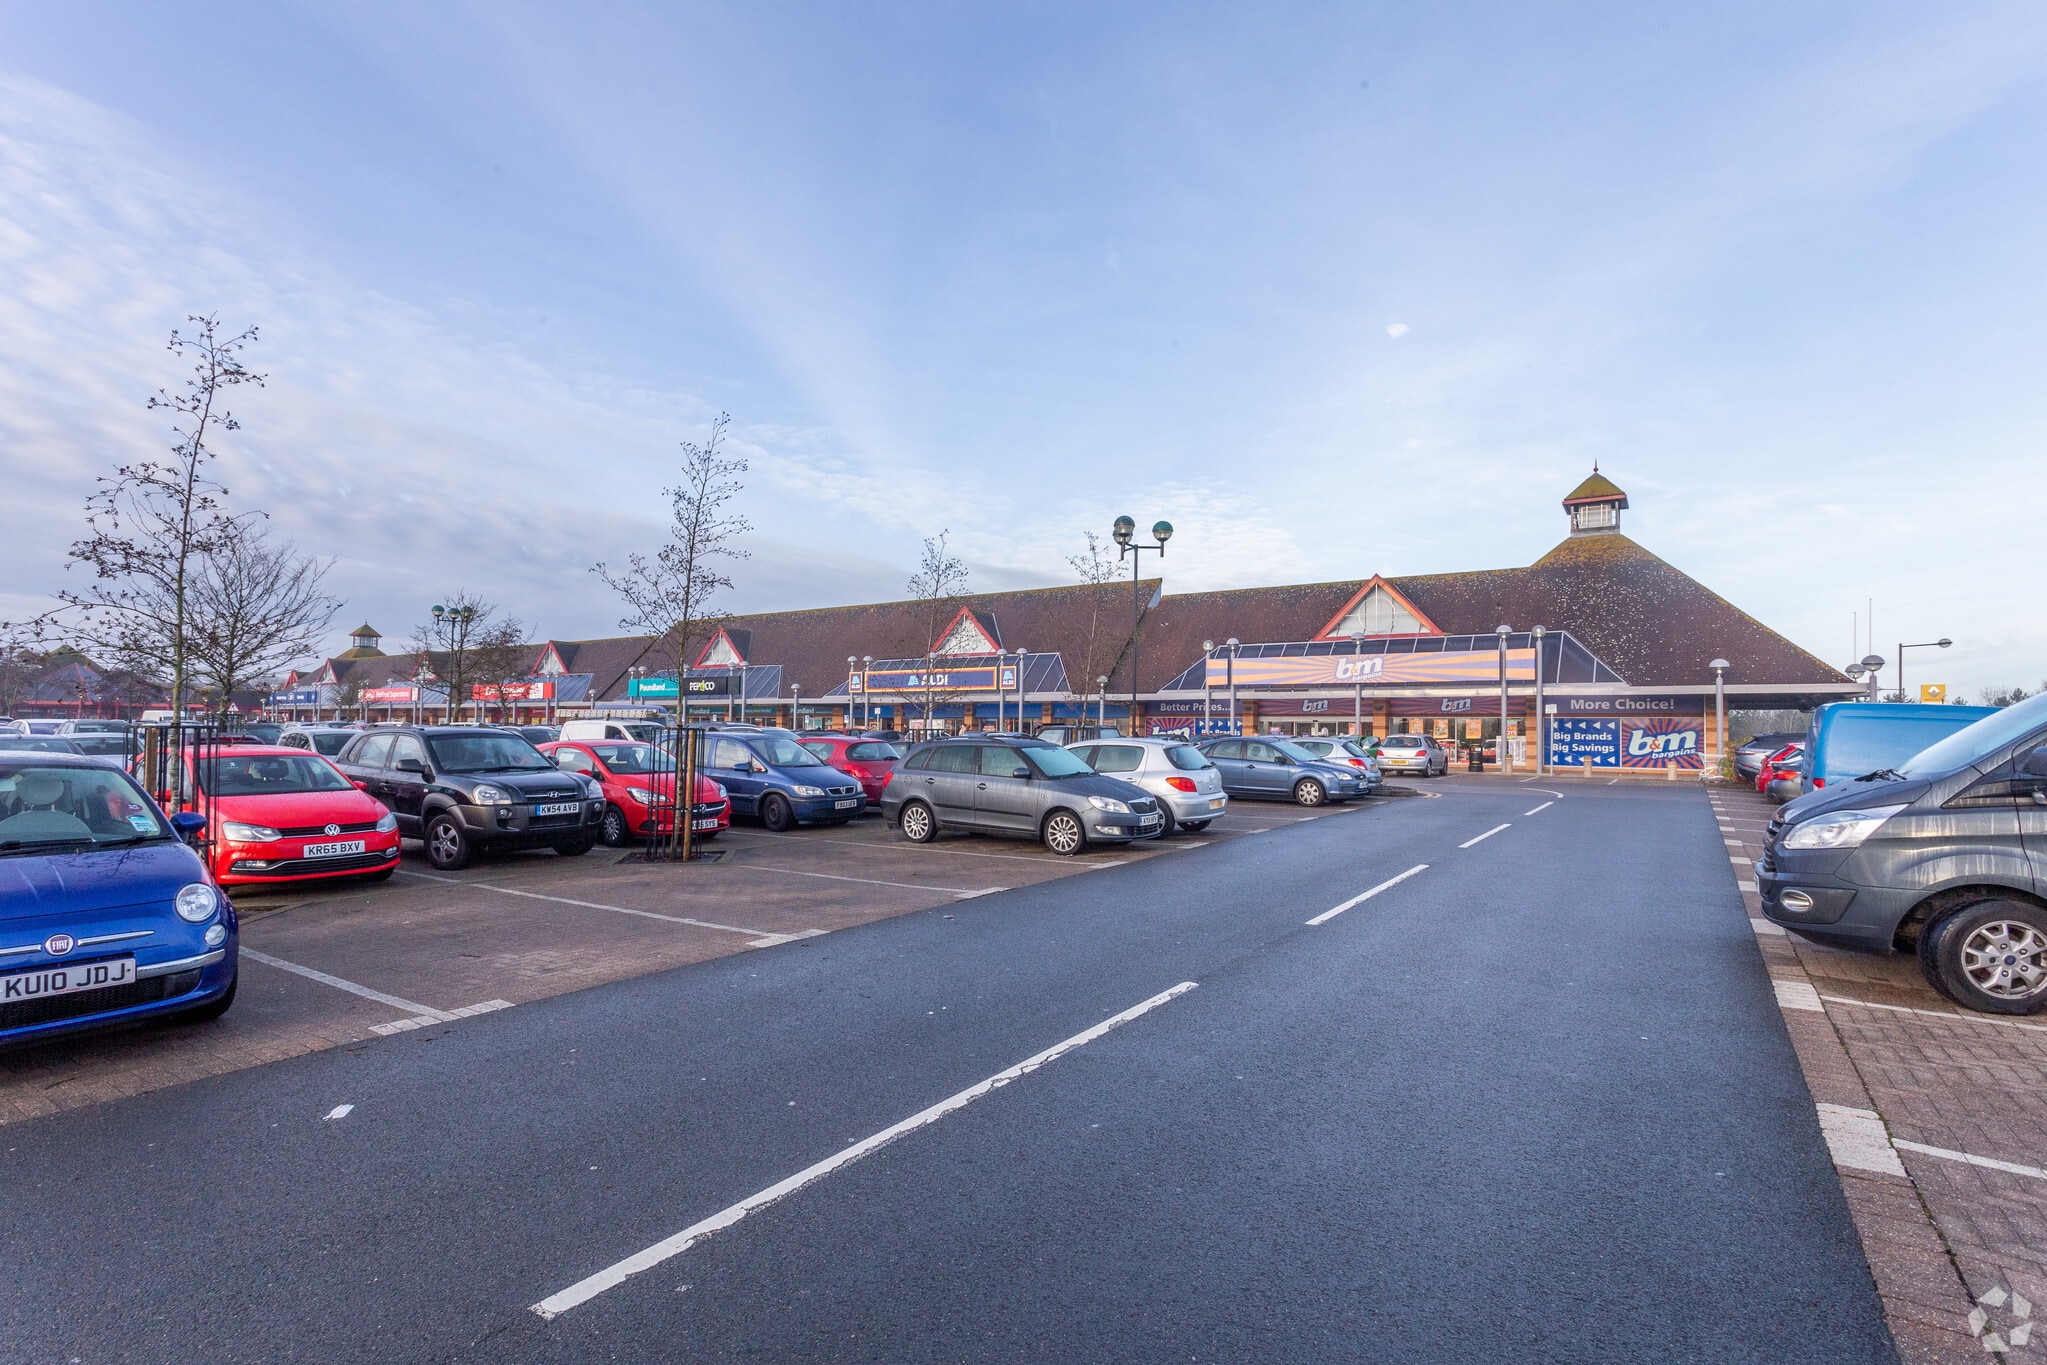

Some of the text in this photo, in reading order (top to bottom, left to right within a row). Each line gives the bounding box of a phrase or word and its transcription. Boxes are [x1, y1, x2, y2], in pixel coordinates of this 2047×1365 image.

[1336, 657, 1383, 679] b&m
[921, 674, 948, 685] ALDI
[1352, 671, 1383, 681] bargains
[640, 683, 665, 692] Poundland
[1160, 702, 1231, 711] Better Pries...
[1570, 698, 1674, 710] More Choice!
[1554, 732, 1612, 742] Big Brands
[1629, 729, 1696, 756] b&m
[1552, 743, 1615, 752] Big Savings
[1652, 748, 1696, 759] bargains
[563, 803, 578, 812] AVB
[308, 842, 360, 856] KR65 BXV
[52, 939, 68, 951] FIAT
[5, 963, 126, 998] KU10 JDJ
